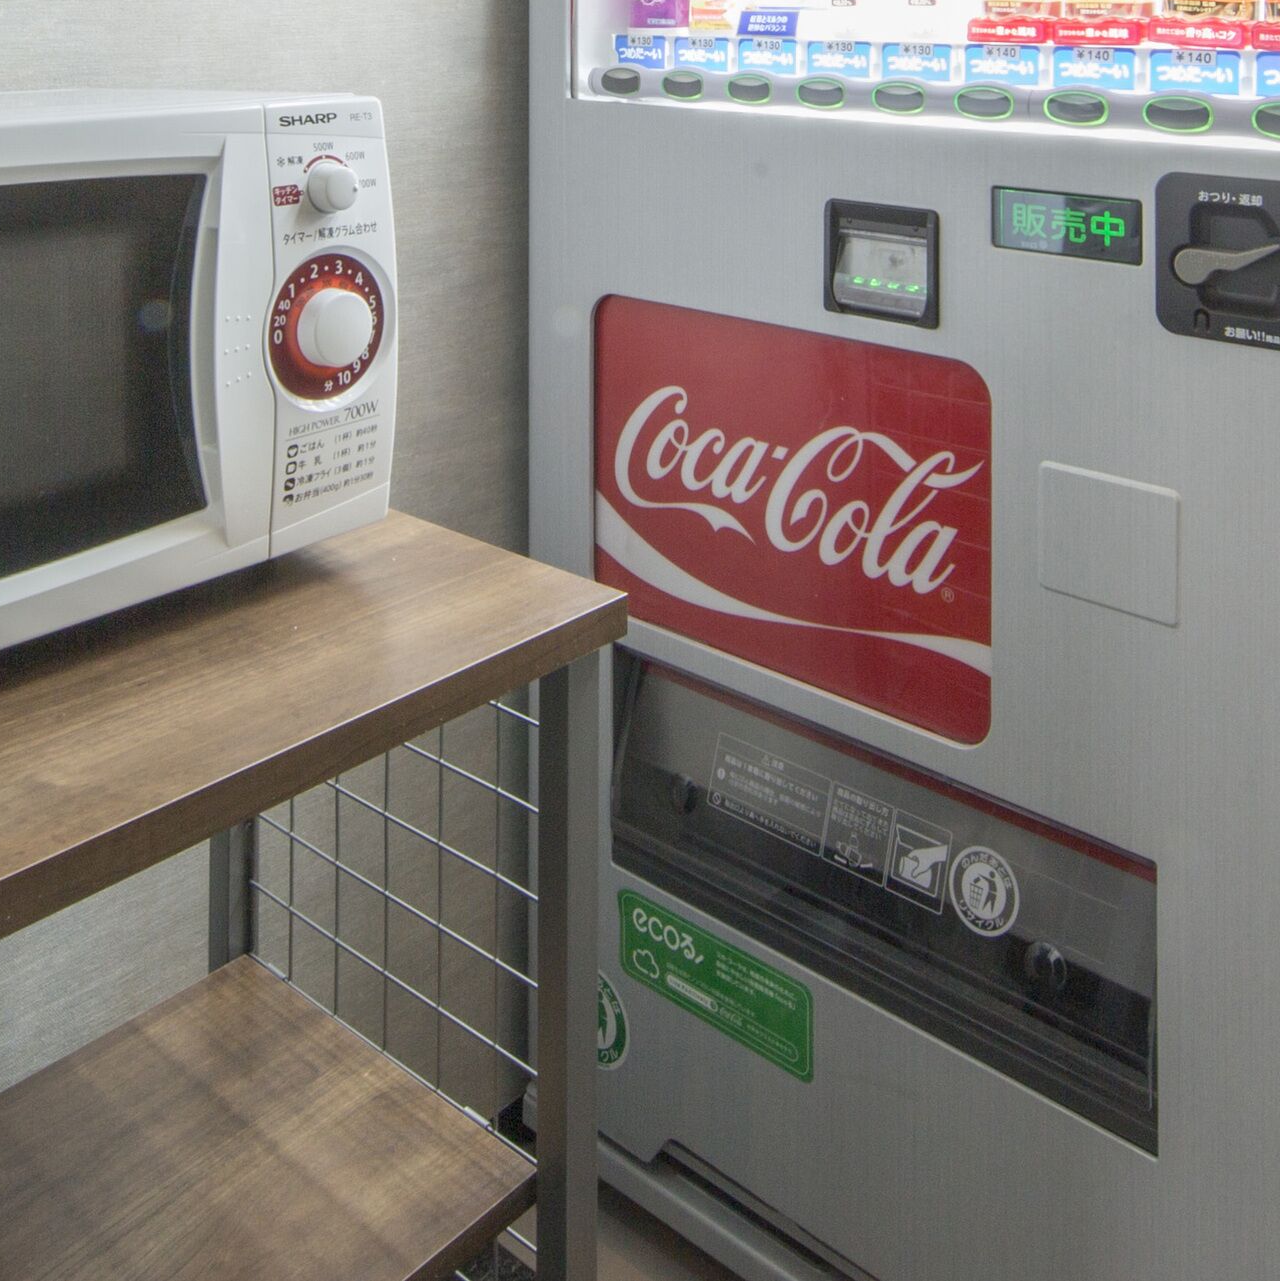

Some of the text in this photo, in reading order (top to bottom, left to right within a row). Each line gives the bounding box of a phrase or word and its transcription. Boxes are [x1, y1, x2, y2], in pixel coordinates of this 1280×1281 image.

[630, 36, 651, 45] ¥130
[691, 38, 713, 47] ¥130
[756, 40, 780, 49] ¥130
[827, 42, 852, 52] ¥130
[904, 46, 930, 55] ¥130
[987, 48, 1016, 58] ¥140
[1077, 50, 1110, 61] ¥140
[1176, 52, 1212, 64] ¥140
[279, 113, 337, 127] SHARP
[313, 142, 334, 152] 500W
[345, 152, 365, 161] 600W
[359, 179, 376, 188] 00W
[274, 186, 299, 196] キッチン
[275, 197, 299, 205] タイマー
[1198, 191, 1263, 207] おつり・返却
[1012, 202, 1125, 247] 販売中
[310, 264, 319, 279] 2
[335, 260, 343, 275] 3
[355, 272, 363, 286] 4
[289, 284, 295, 298] 1
[278, 299, 291, 311] 40
[369, 295, 376, 309] 5
[274, 315, 286, 327] 20
[274, 330, 283, 344] 0
[353, 360, 361, 374] 9
[337, 371, 351, 385] 10
[324, 380, 333, 392] 分
[289, 400, 379, 437] HIGH POWER 700W
[299, 440, 325, 454] ごはん
[614, 385, 983, 595] Coca-Cola
[958, 900, 1005, 931] リサイクル
